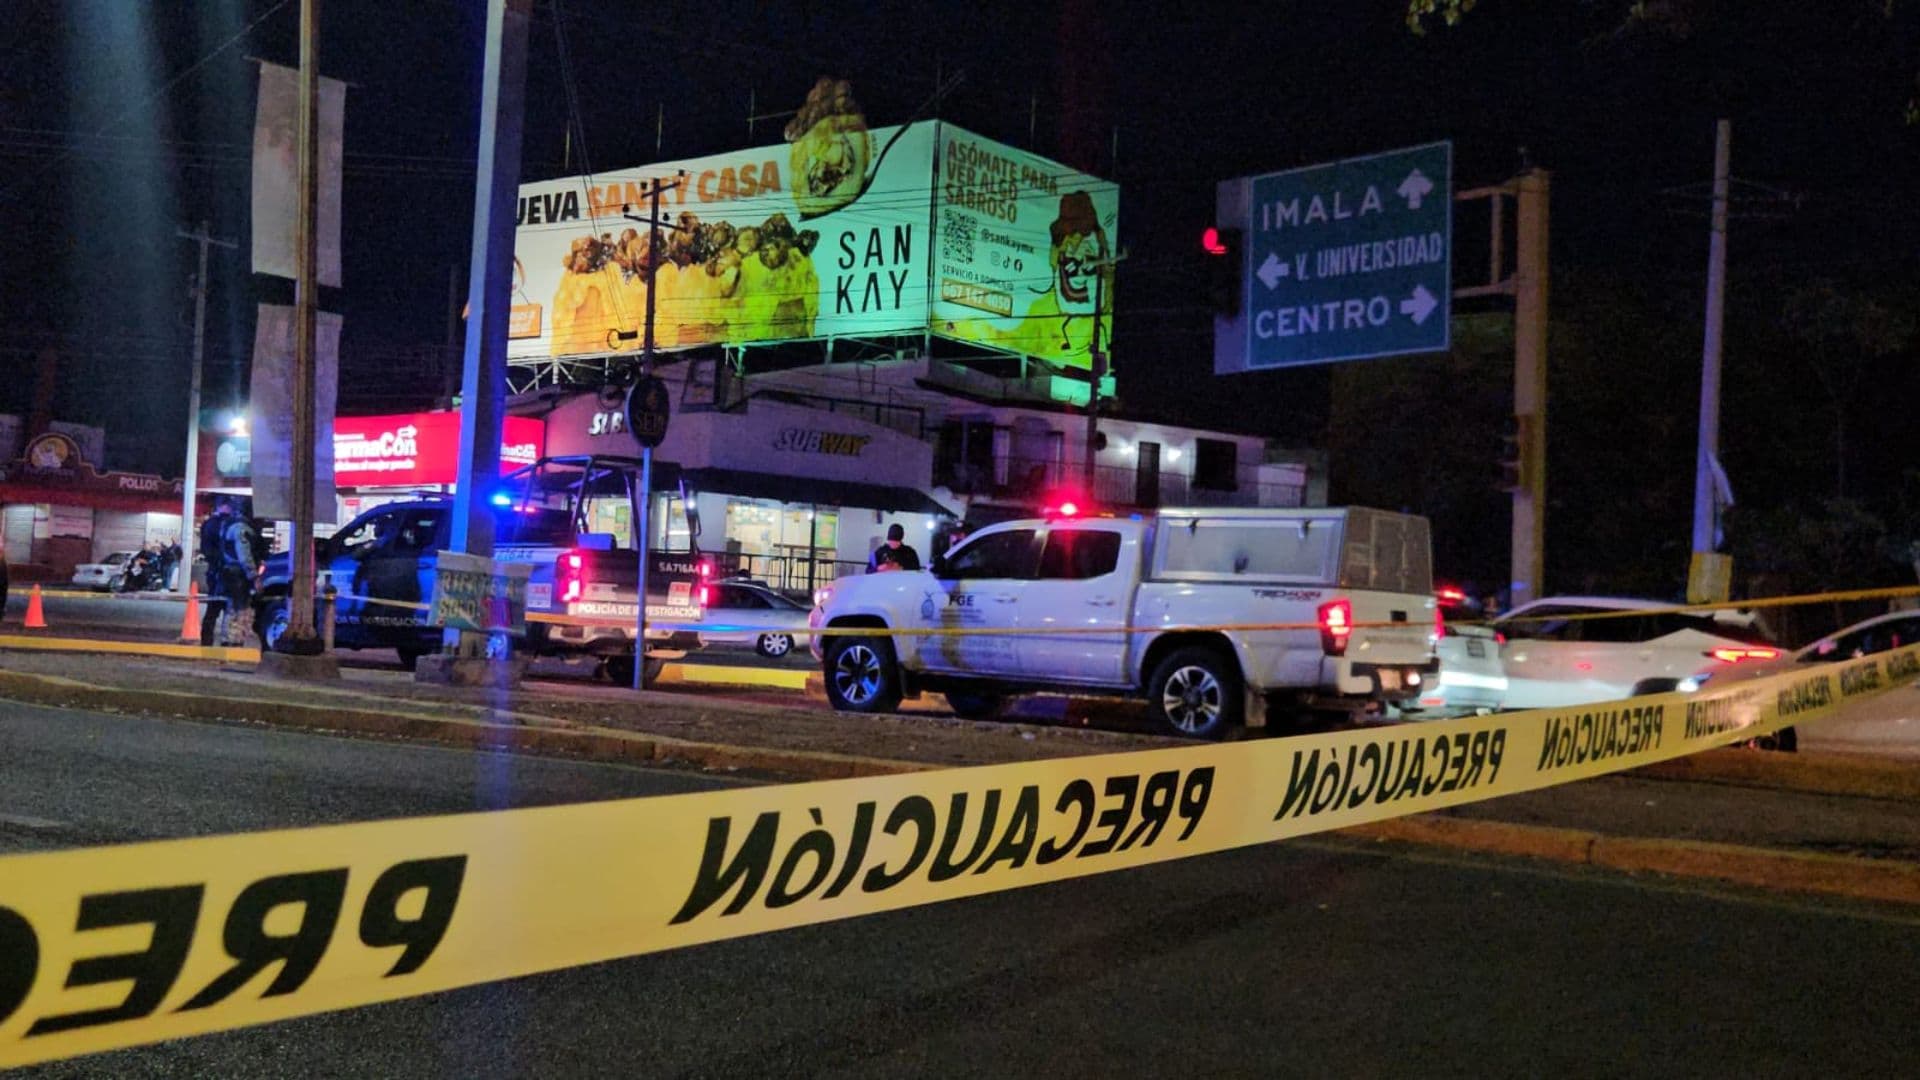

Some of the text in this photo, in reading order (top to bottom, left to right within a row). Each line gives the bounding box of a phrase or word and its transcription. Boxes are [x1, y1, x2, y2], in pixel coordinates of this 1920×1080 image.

[947, 140, 1016, 179] ASÓMATE
[517, 190, 579, 226] UEVA
[697, 160, 781, 204] CASA
[947, 160, 1017, 200] VER ALGO
[945, 183, 1017, 223] SABROSO
[1263, 185, 1384, 231] IMALA
[838, 223, 911, 269] SAN
[1317, 232, 1442, 278] UNIVERSIDAD
[836, 269, 909, 314] KAY
[1255, 295, 1391, 339] CENTRO
[588, 412, 626, 435] SUB
[773, 428, 871, 456] SUBWAY
[120, 476, 160, 490] POLLOS
[577, 602, 617, 615] POLICÍA
[618, 605, 631, 615] DE
